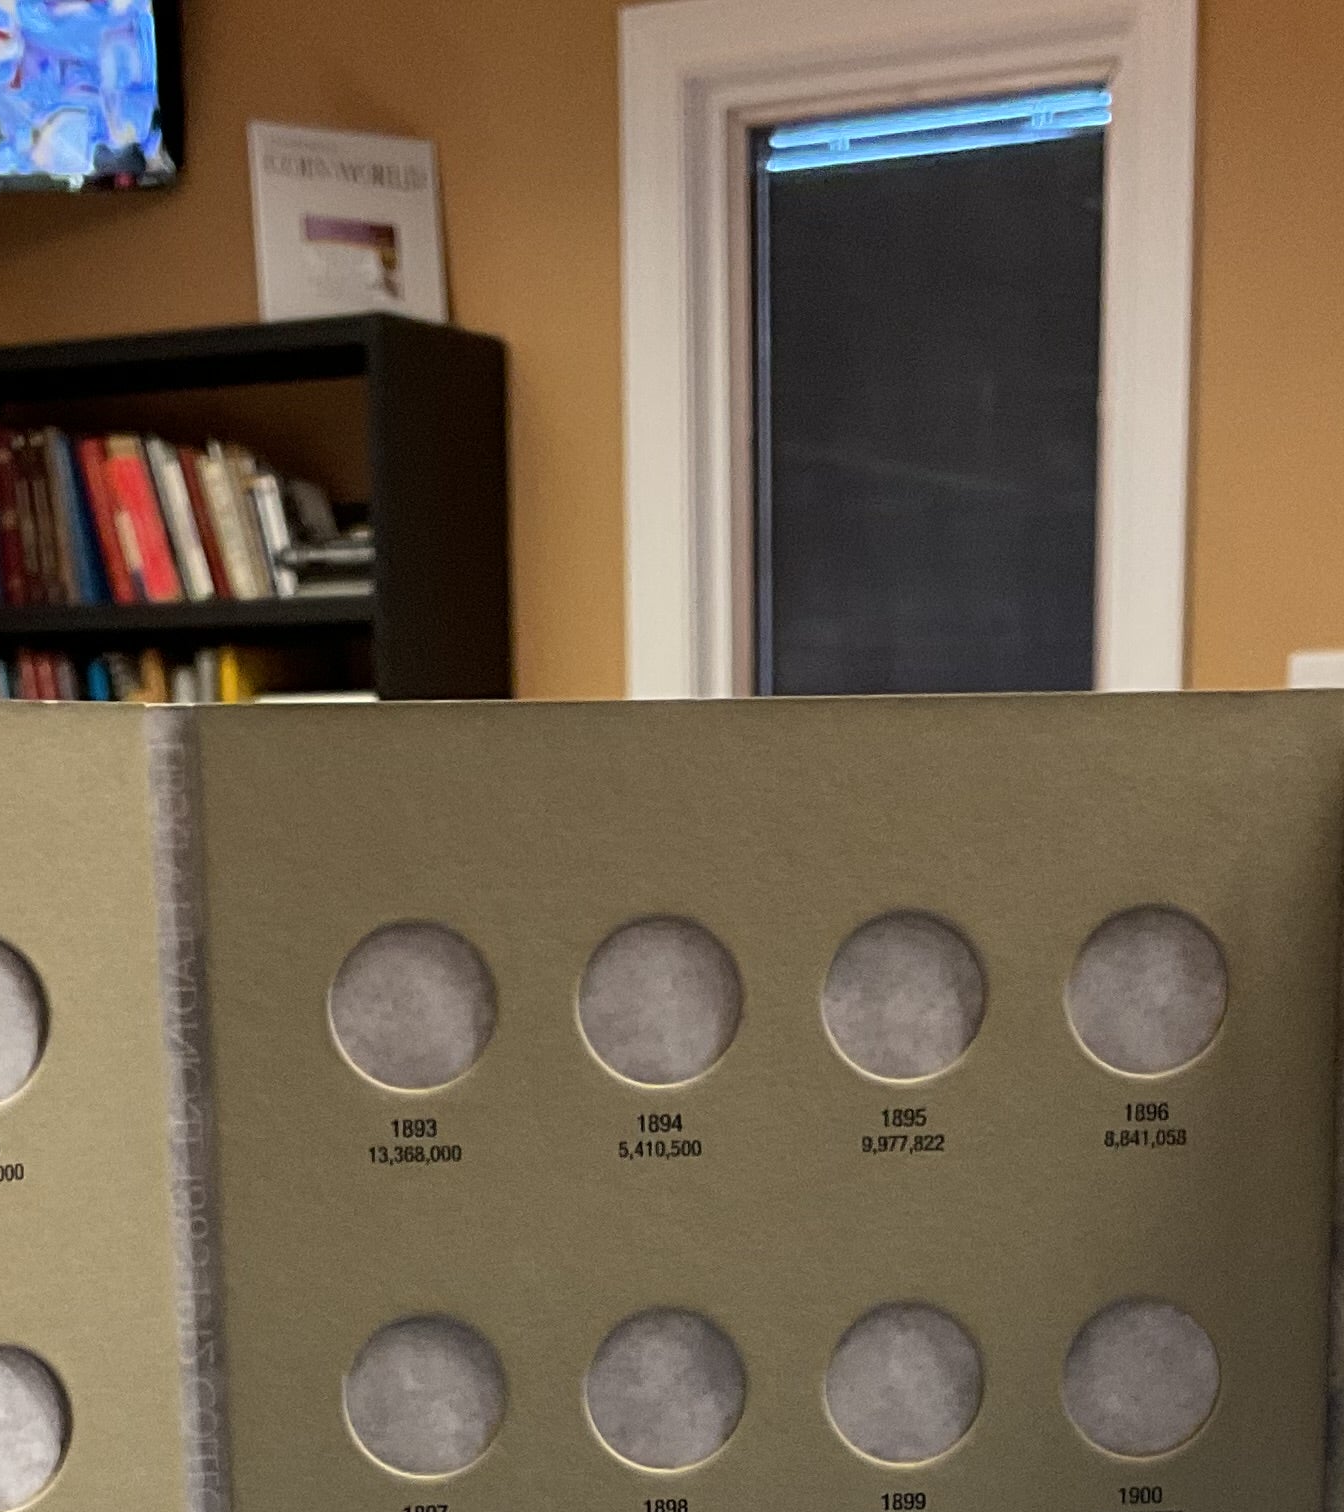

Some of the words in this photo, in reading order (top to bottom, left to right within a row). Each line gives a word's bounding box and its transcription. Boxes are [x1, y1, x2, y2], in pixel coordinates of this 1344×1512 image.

[881, 1108, 928, 1128] 1895
[1124, 1103, 1170, 1122] 1896
[390, 1119, 438, 1139] 1893
[636, 1114, 684, 1134] 1894
[368, 1144, 463, 1165] 13,368,000
[618, 1140, 703, 1161] 5,410,500
[881, 1492, 927, 1512] 1899
[1117, 1486, 1163, 1506] 1900
